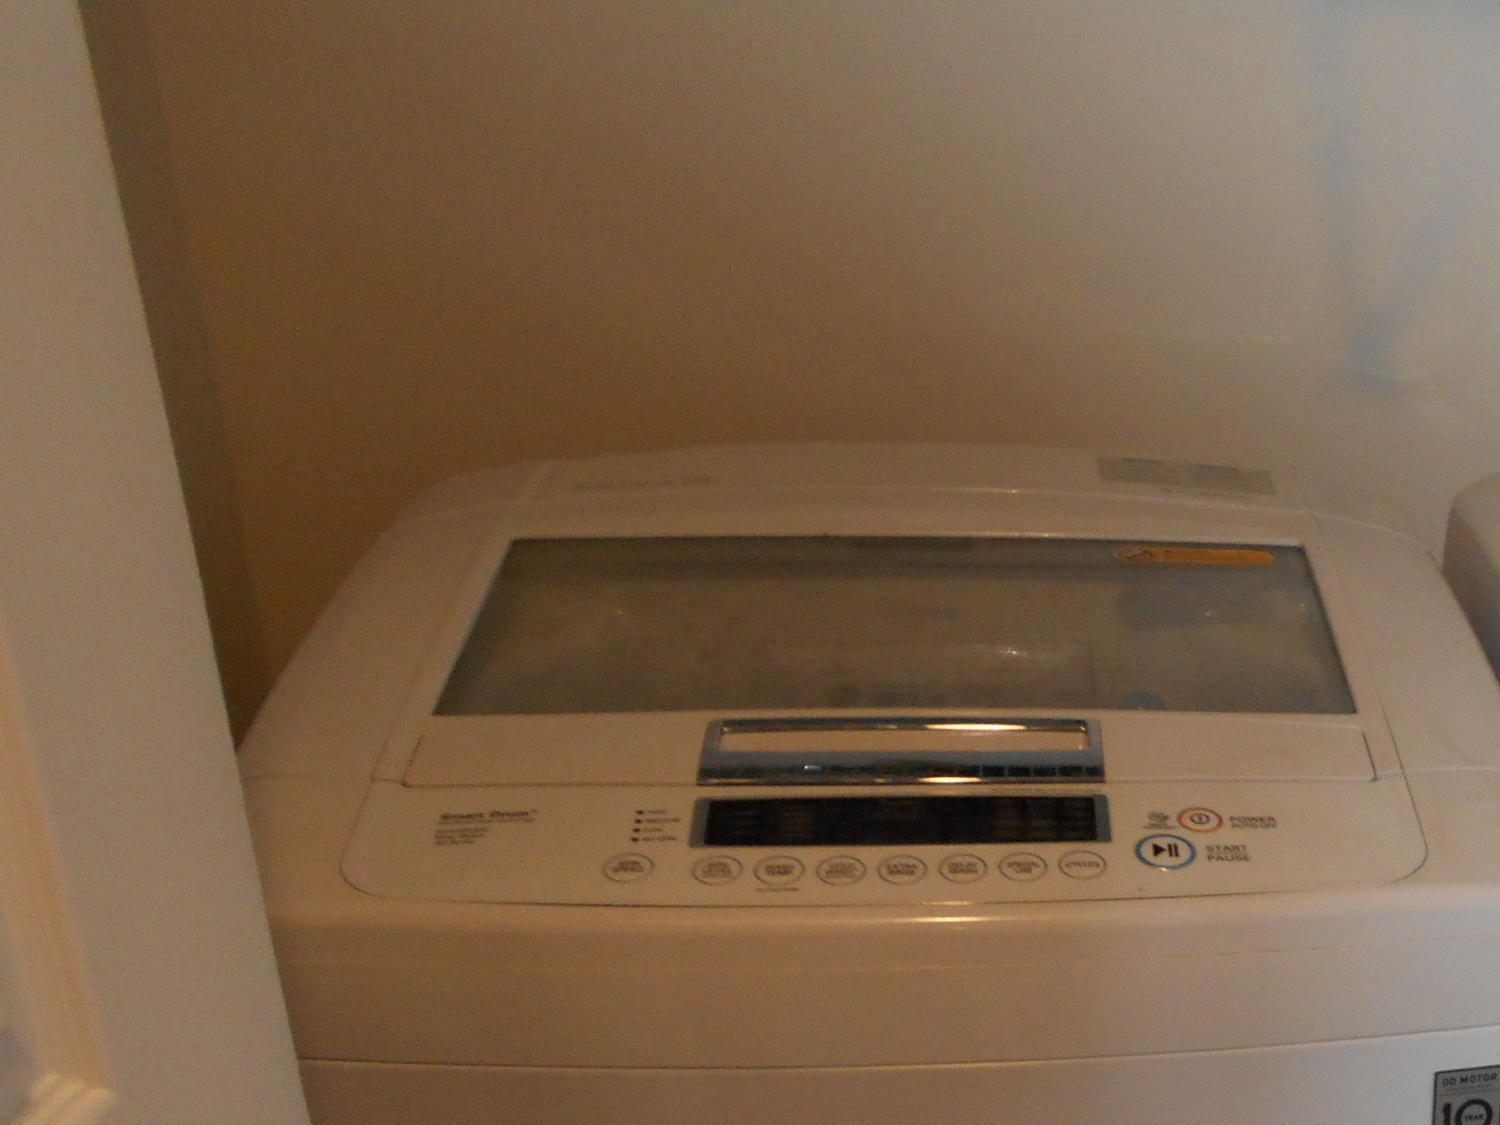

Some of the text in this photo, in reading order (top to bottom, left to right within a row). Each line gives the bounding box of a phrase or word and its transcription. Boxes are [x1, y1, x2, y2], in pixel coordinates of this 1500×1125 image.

[1229, 815, 1276, 823] POWER
[1206, 844, 1247, 853] START
[1207, 854, 1250, 862] PAUSE
[1460, 1073, 1498, 1084] MOTOR
